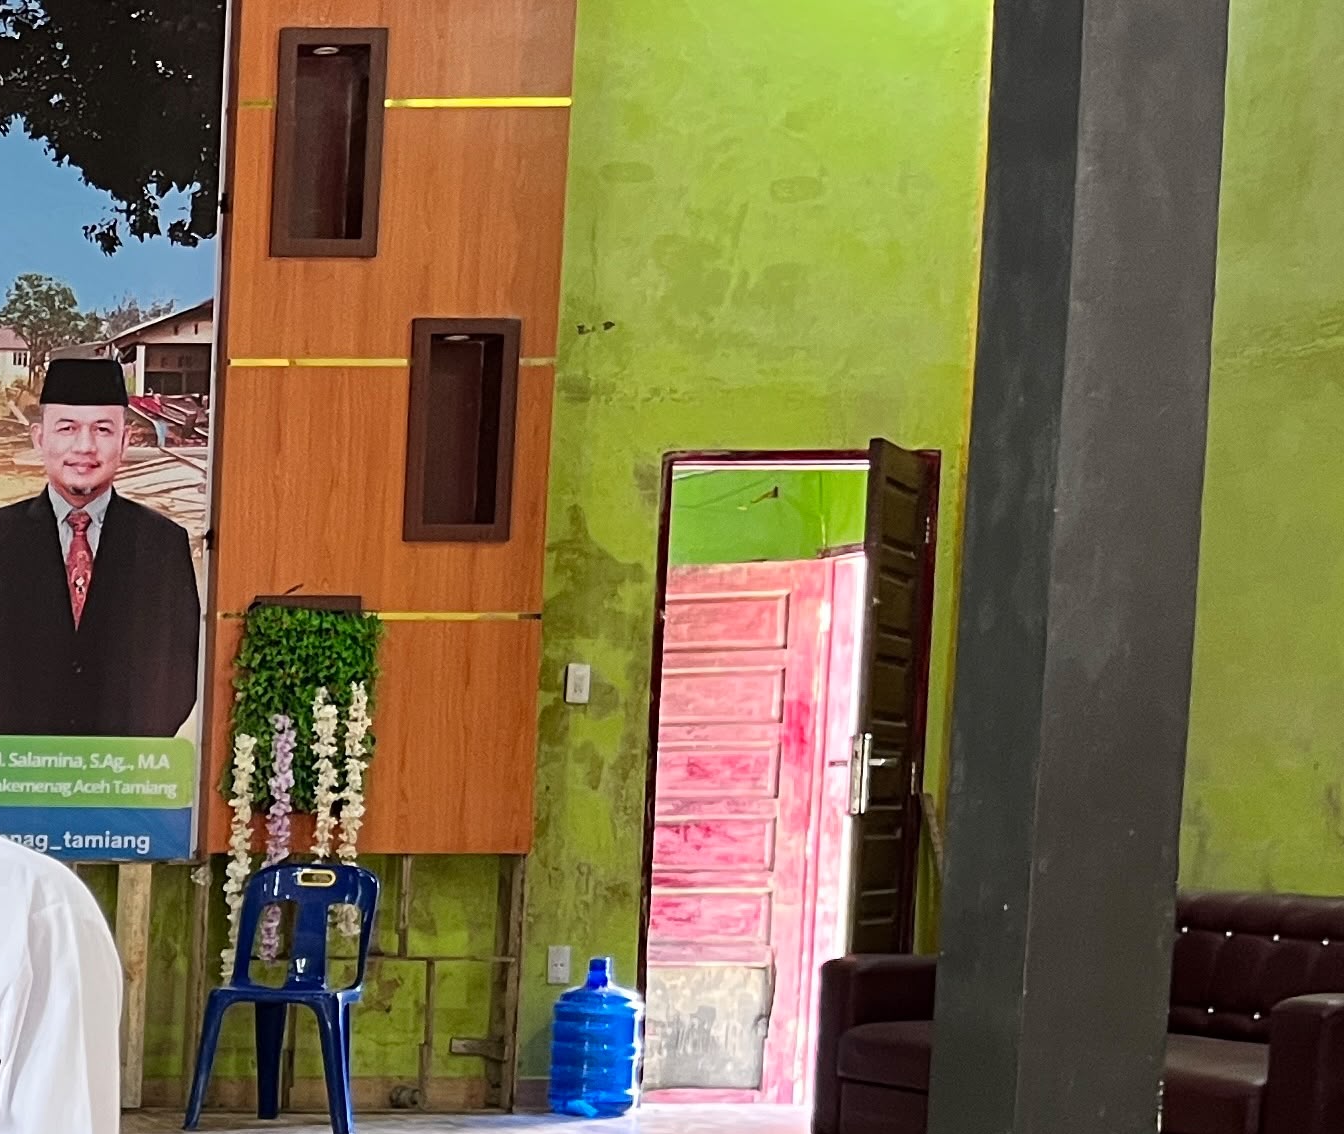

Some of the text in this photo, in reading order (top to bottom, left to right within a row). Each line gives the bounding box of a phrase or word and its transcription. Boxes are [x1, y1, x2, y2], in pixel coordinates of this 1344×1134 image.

[8, 751, 88, 770] Salamina,
[73, 779, 110, 794] Aceh
[113, 780, 178, 799] Tamiang
